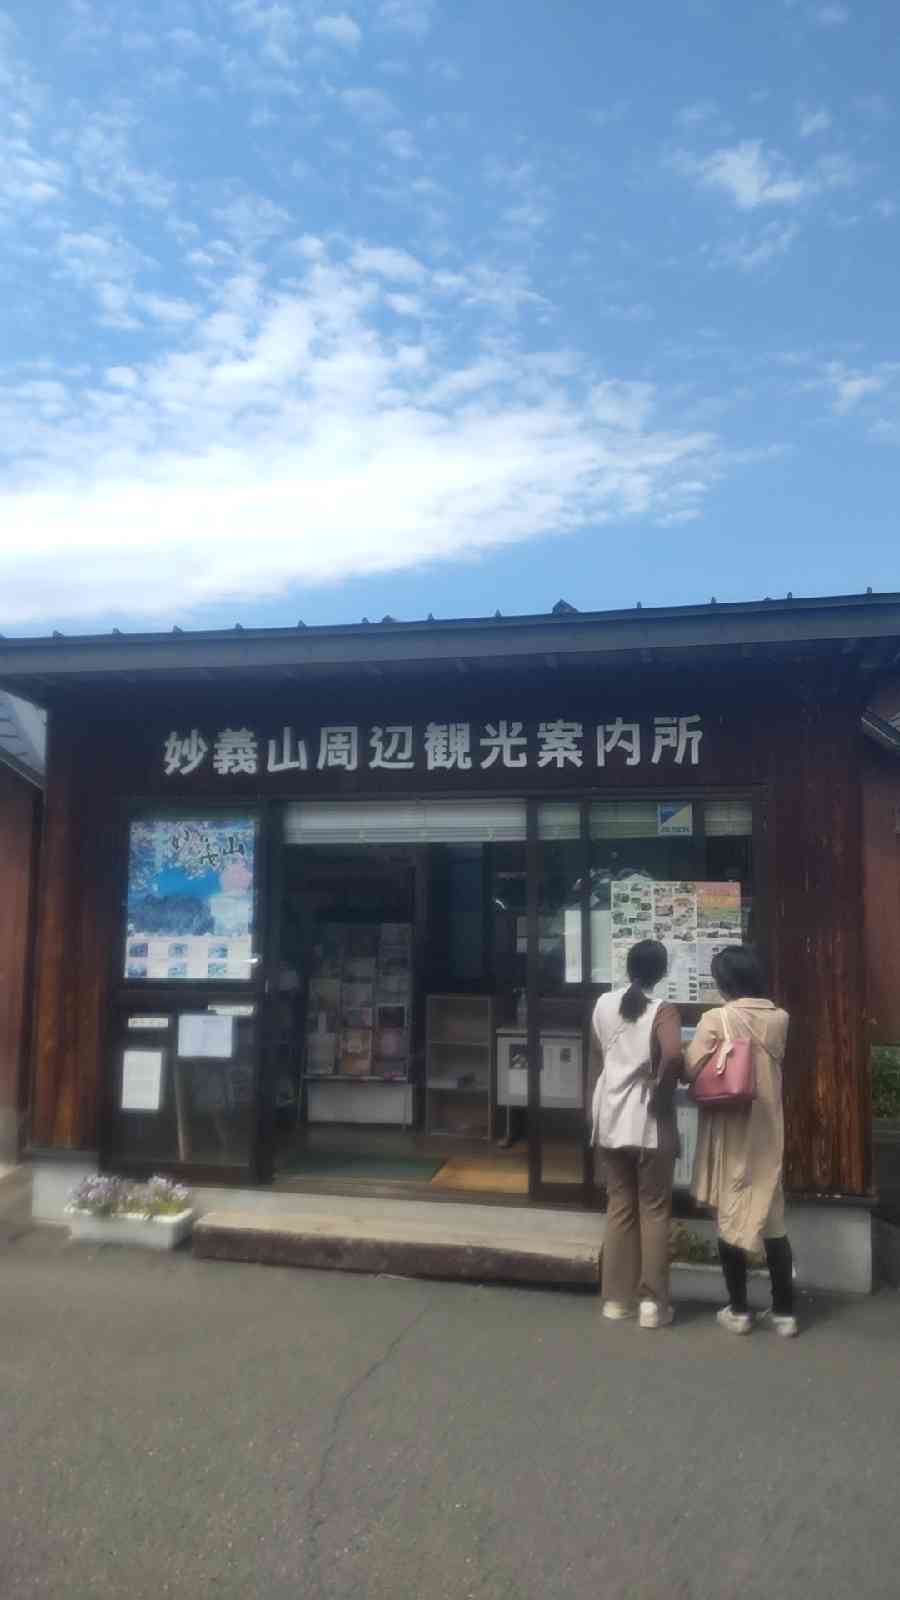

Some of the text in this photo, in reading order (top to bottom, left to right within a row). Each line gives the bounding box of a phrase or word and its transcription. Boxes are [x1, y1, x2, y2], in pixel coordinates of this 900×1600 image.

[164, 714, 703, 775] 妙義山周辺観光案内所
